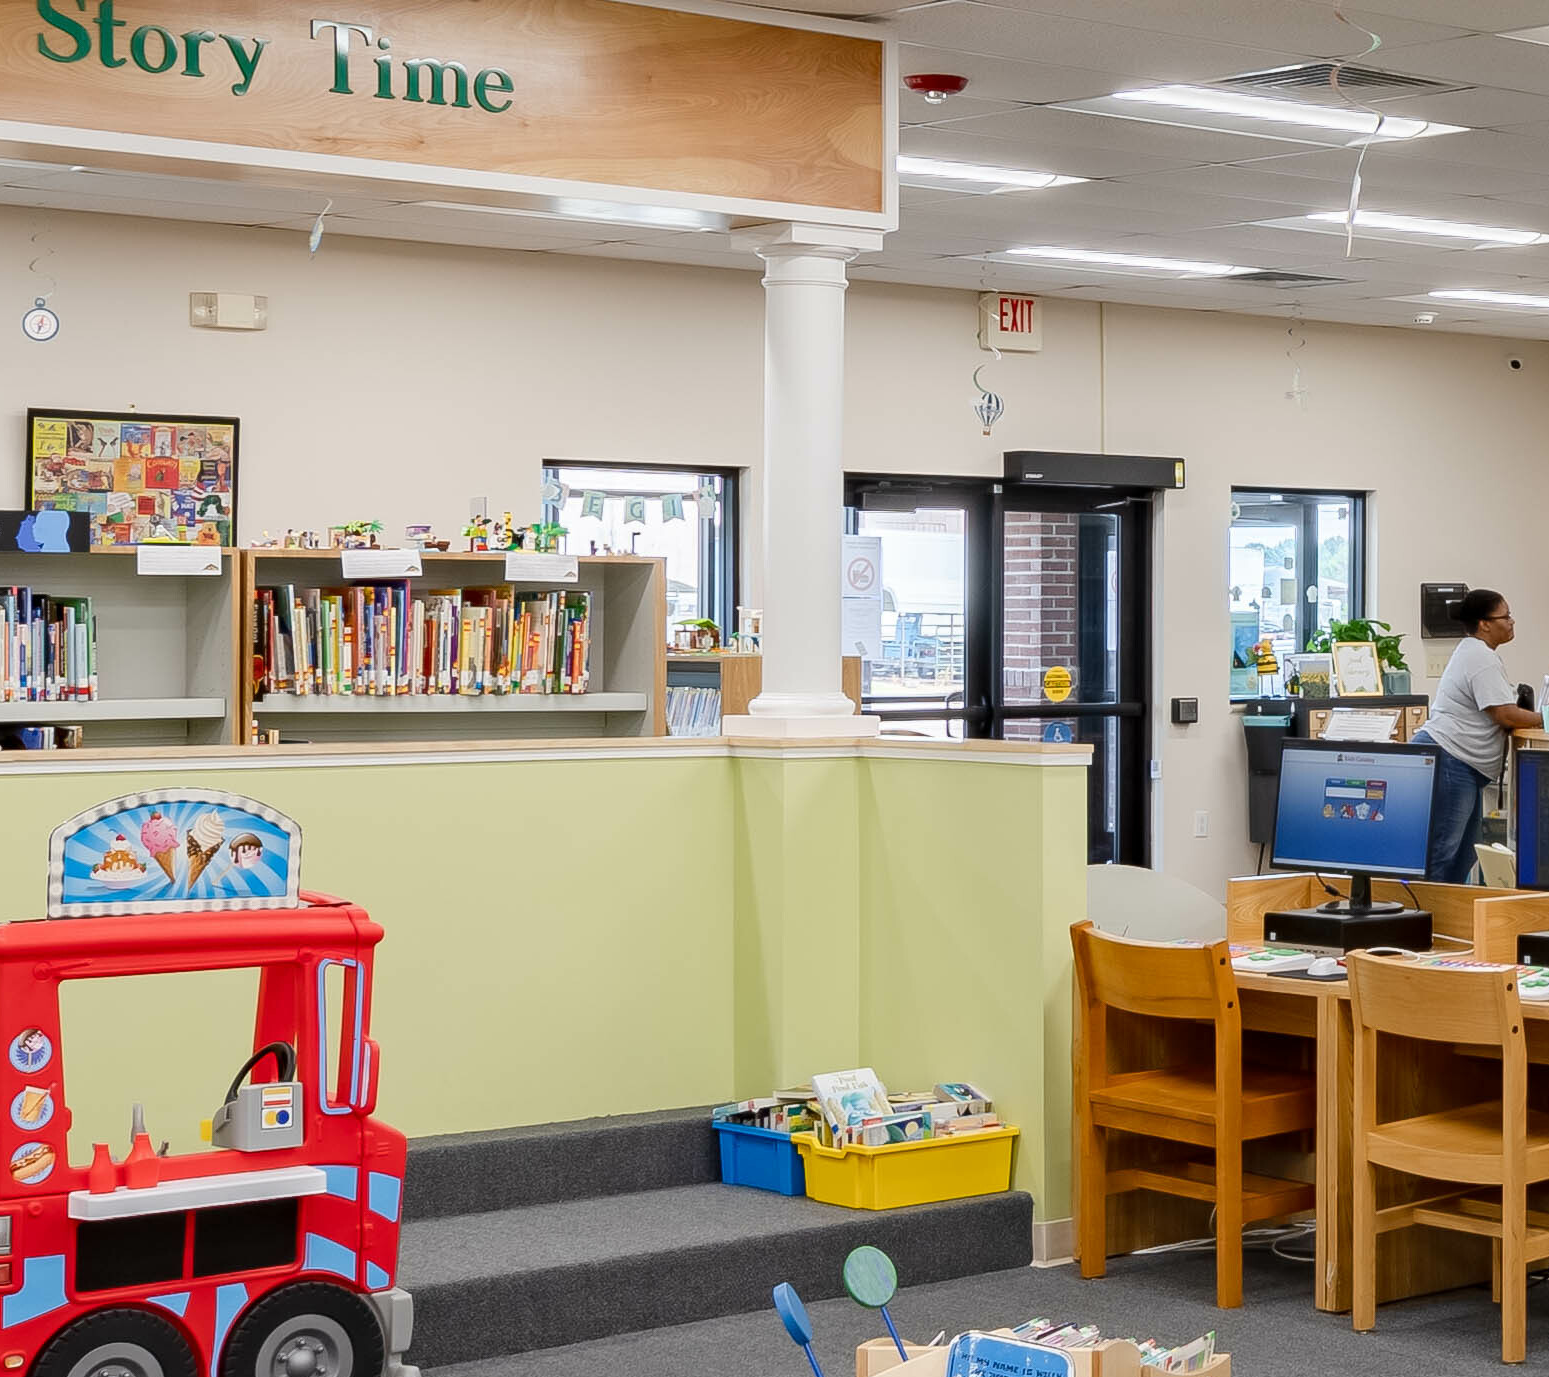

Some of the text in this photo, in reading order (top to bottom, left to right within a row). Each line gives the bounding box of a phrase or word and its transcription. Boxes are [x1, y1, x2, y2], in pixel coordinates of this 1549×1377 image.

[310, 18, 514, 113] Time
[999, 297, 1035, 333] EXIT
[992, 1362, 1019, 1374] NAME
